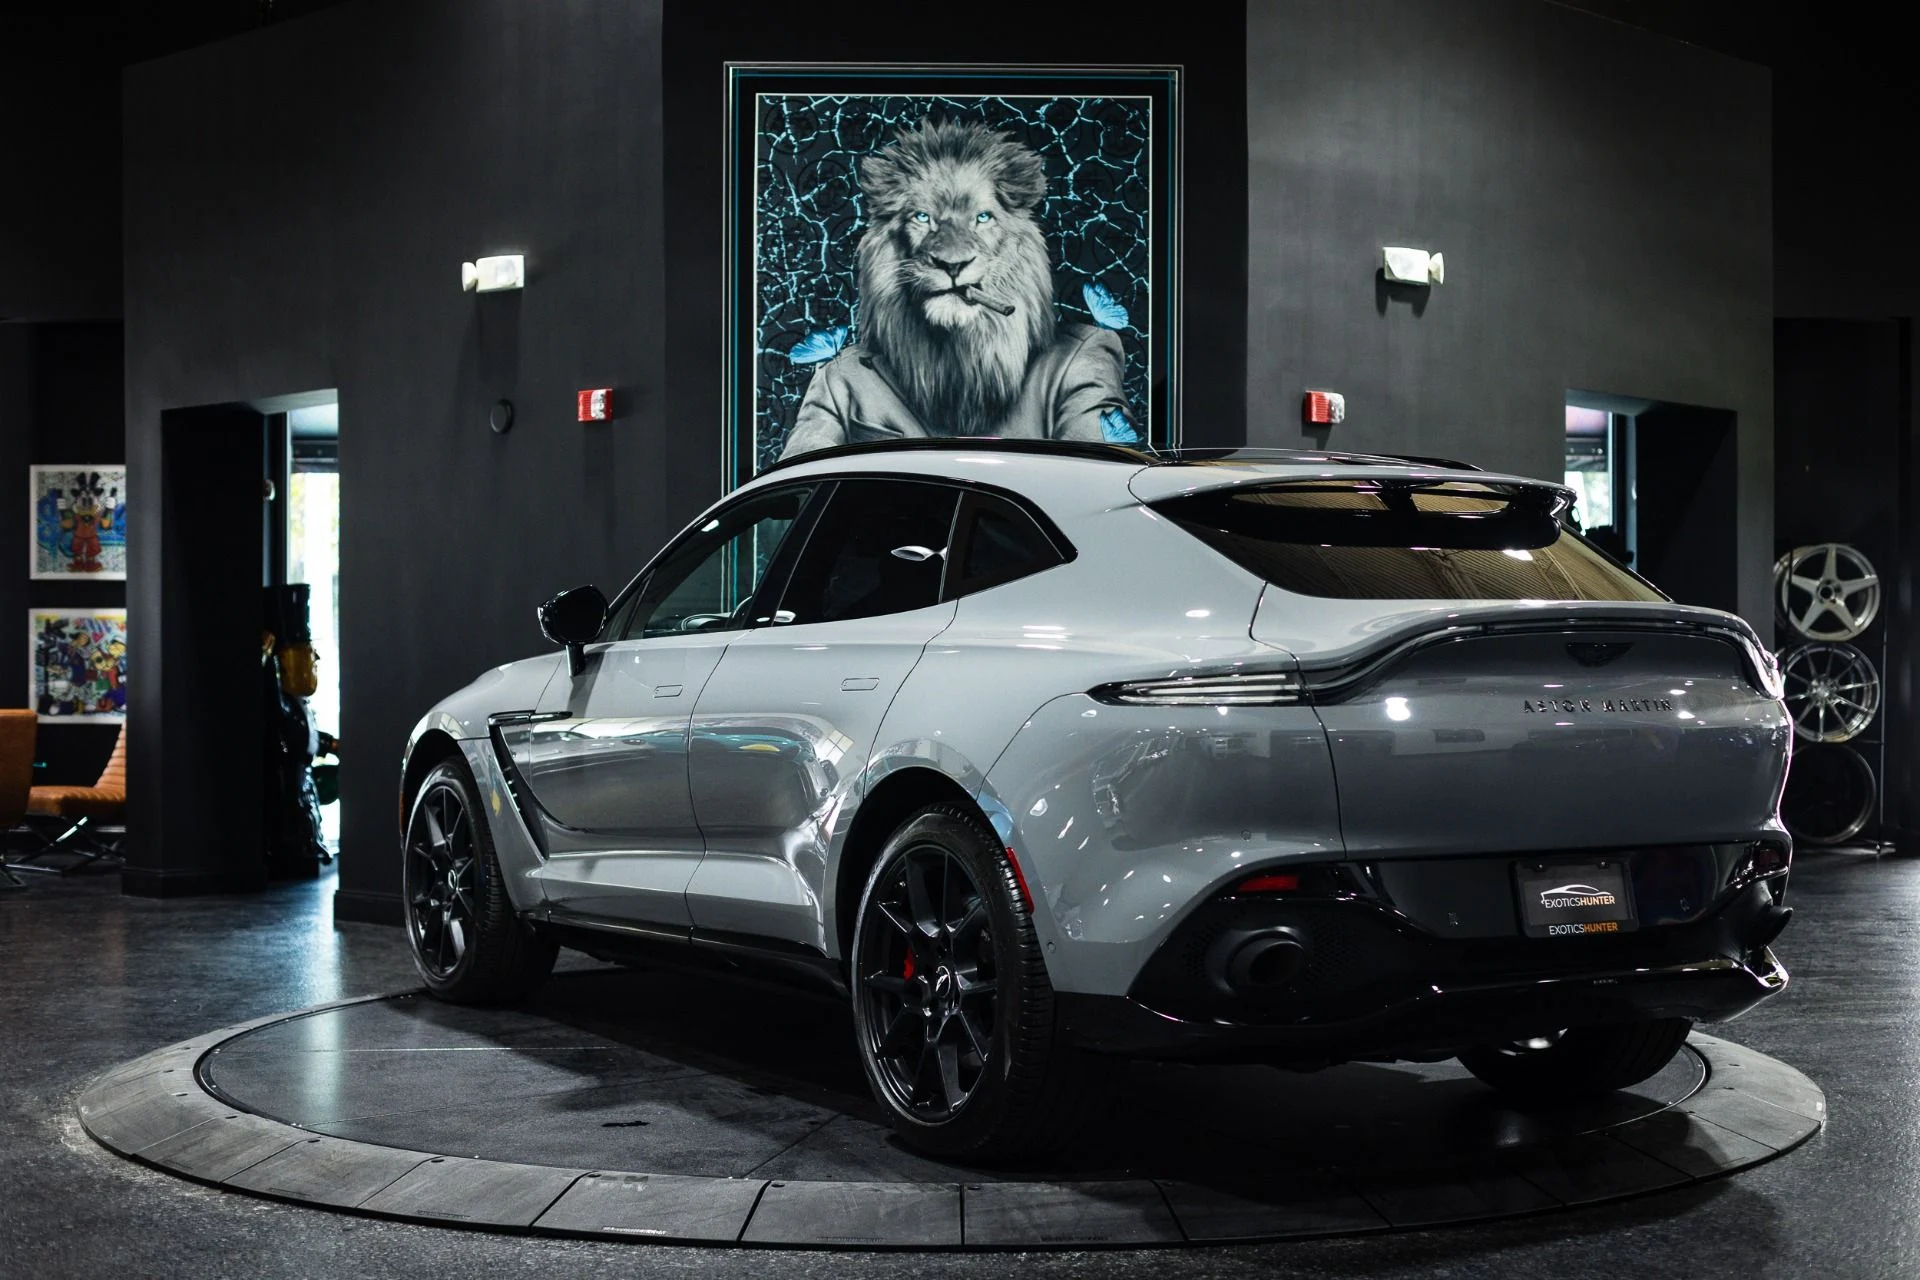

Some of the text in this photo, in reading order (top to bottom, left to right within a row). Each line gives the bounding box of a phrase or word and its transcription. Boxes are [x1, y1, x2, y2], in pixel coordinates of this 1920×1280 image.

[1523, 698, 1673, 713] ASTON MARTIN
[1545, 895, 1615, 909] EXOTICSHUNTER
[1548, 922, 1619, 935] EXOTICSHUNTER
